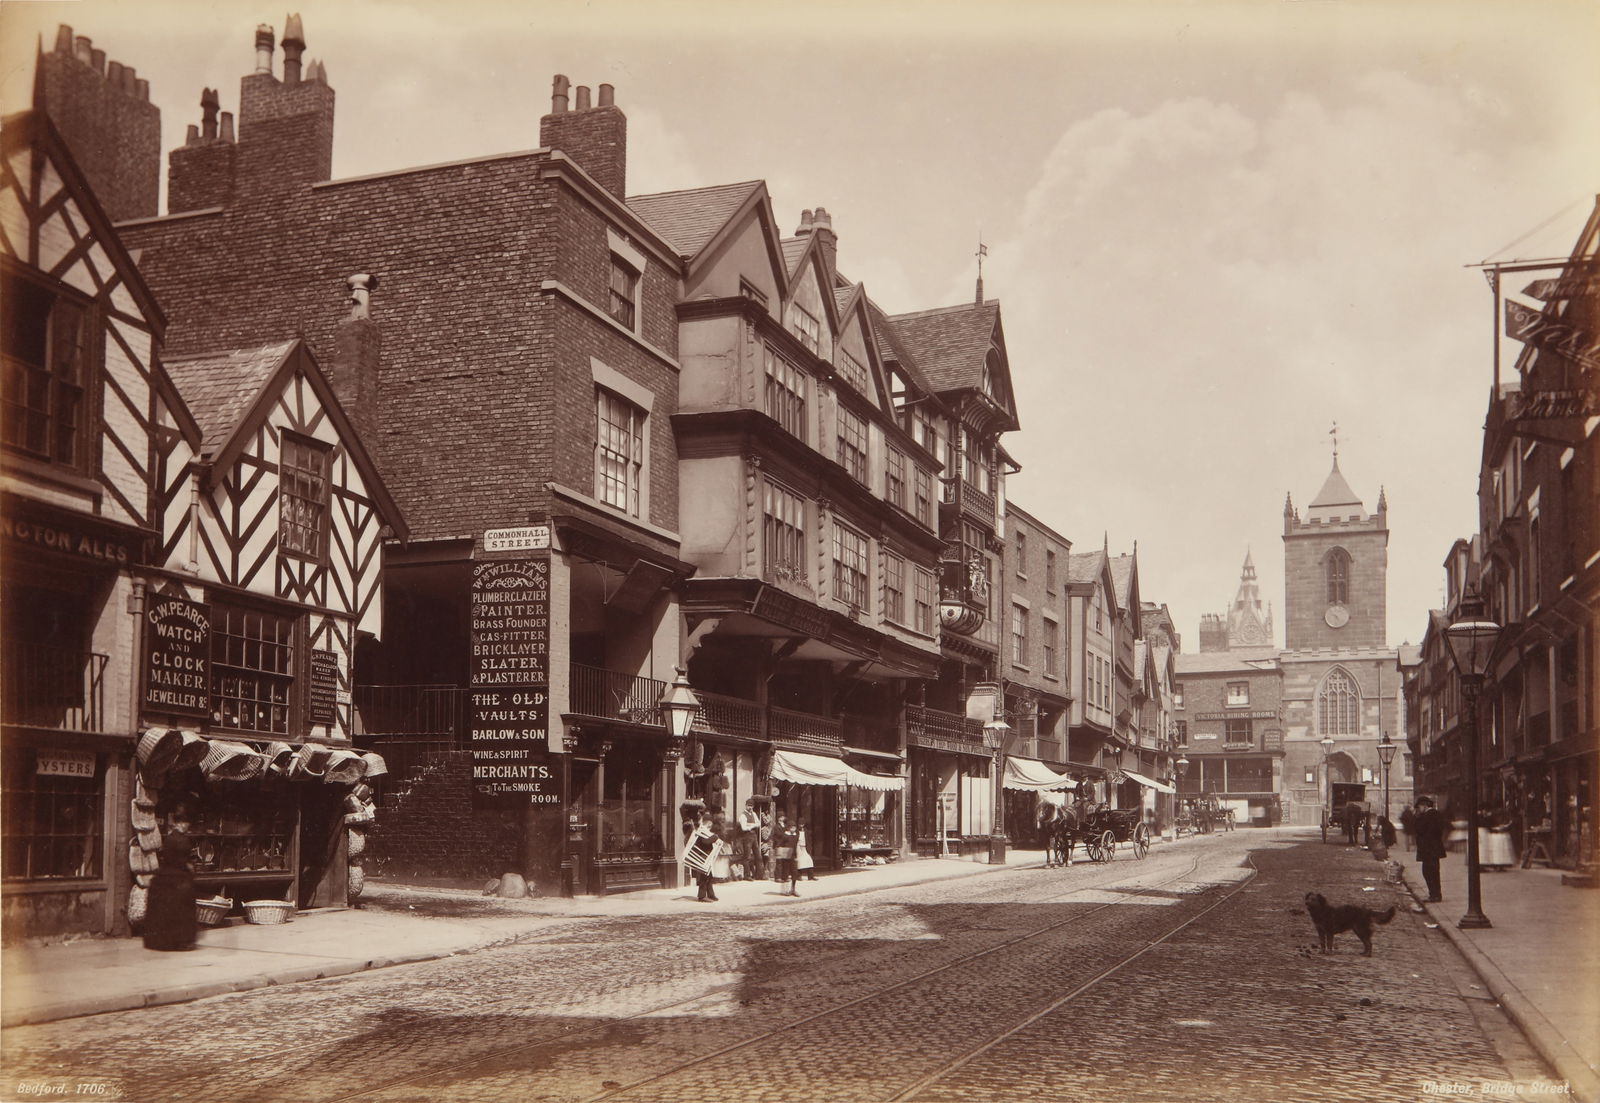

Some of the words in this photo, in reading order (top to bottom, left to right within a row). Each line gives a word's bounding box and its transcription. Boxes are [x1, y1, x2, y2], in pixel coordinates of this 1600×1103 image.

[487, 529, 547, 540] COMMONHALL
[79, 536, 128, 561] ALES
[492, 539, 543, 548] STREET.
[488, 563, 547, 589] WILLIAMS
[480, 604, 547, 617] PAINTER.
[473, 619, 504, 629] BRASS
[506, 618, 547, 628] FOUNDER
[156, 623, 202, 643] WATCH
[168, 642, 190, 653] AND
[152, 651, 205, 672] CLOCK
[151, 669, 207, 690] MAKER.
[480, 672, 544, 683] PLASTERER
[146, 689, 196, 707] JEWELLER
[472, 693, 500, 706] THE
[512, 693, 544, 705] OLD
[480, 710, 538, 721] VAULTS
[472, 729, 516, 741] BARLOW
[521, 729, 545, 740] SON
[473, 750, 494, 760] WINE
[499, 750, 530, 759] SPIRIT
[473, 766, 553, 779] MERCHANTS.
[512, 782, 541, 792] SMOKE
[531, 794, 561, 804] ROOM.
